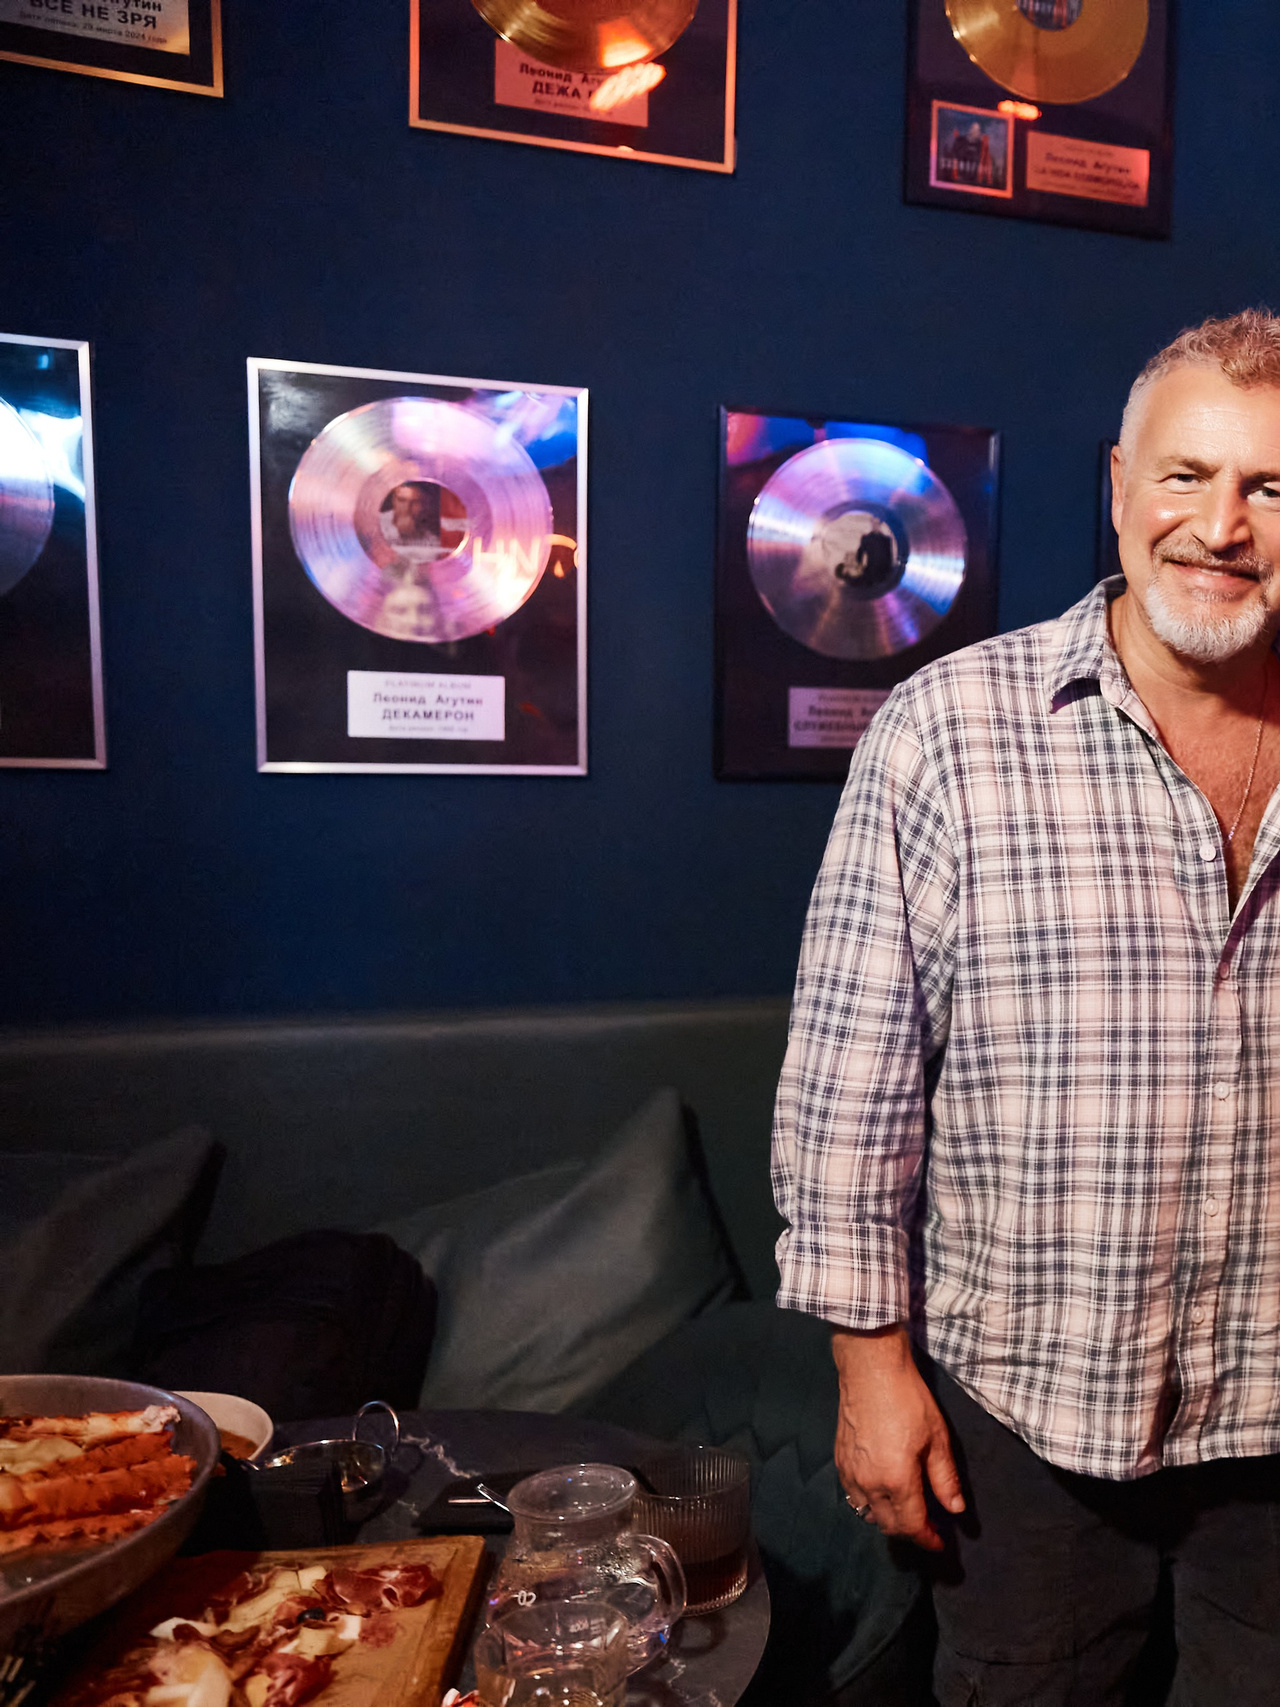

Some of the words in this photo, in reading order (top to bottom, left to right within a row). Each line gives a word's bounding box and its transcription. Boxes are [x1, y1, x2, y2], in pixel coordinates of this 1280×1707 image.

[82, 3, 109, 22] НЕ
[117, 10, 157, 29] ЗРЯ
[532, 80, 581, 100] ДЕЖА
[373, 692, 427, 706] Леонид
[435, 694, 484, 708] Агутин
[382, 708, 475, 722] ДЕКАМЕРОН
